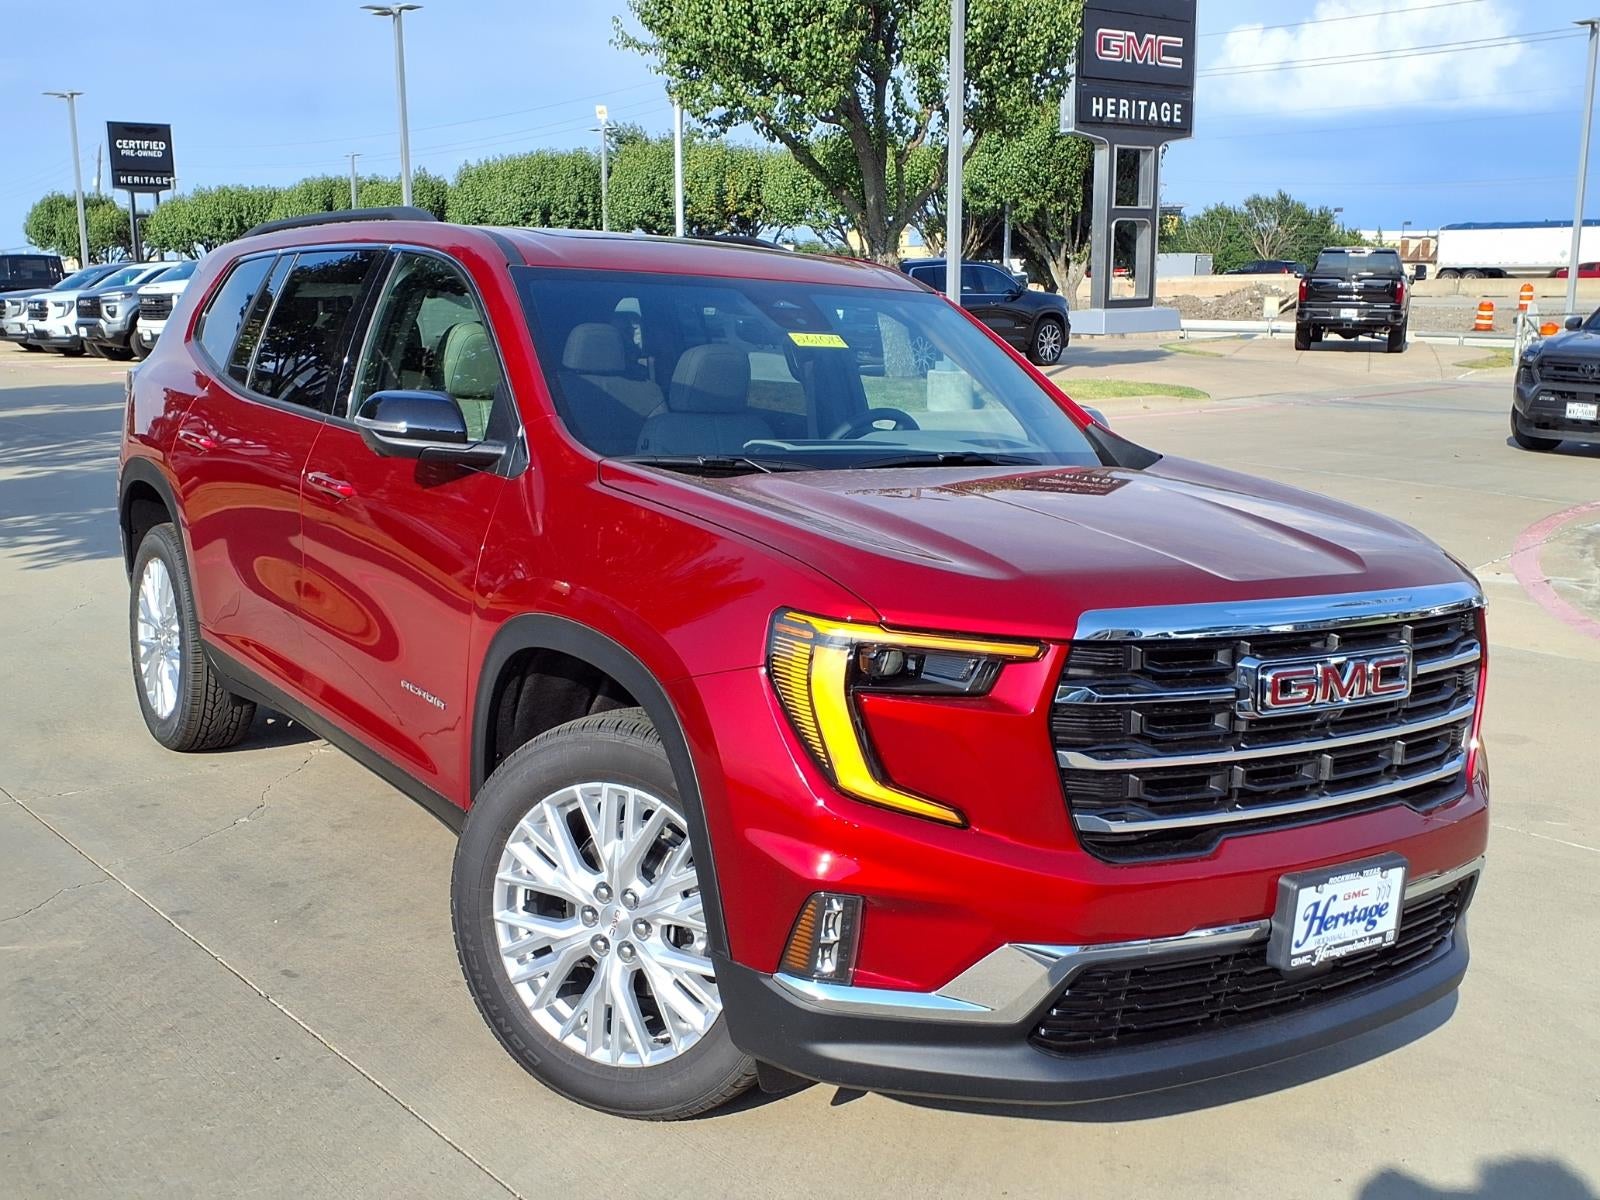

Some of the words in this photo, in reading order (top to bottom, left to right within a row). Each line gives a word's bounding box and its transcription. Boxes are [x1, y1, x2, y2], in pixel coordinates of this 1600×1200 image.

[1096, 28, 1183, 69] GMC
[1092, 96, 1182, 122] HERITAGE
[115, 139, 166, 150] CERTIFIED
[120, 149, 163, 157] PRE-OWNED
[120, 175, 168, 185] HERITAGE
[1267, 655, 1408, 708] GMC
[400, 680, 446, 710] ACADIA
[1343, 888, 1370, 901] GMC
[1294, 894, 1389, 948] Heritage
[1291, 954, 1312, 966] GMC
